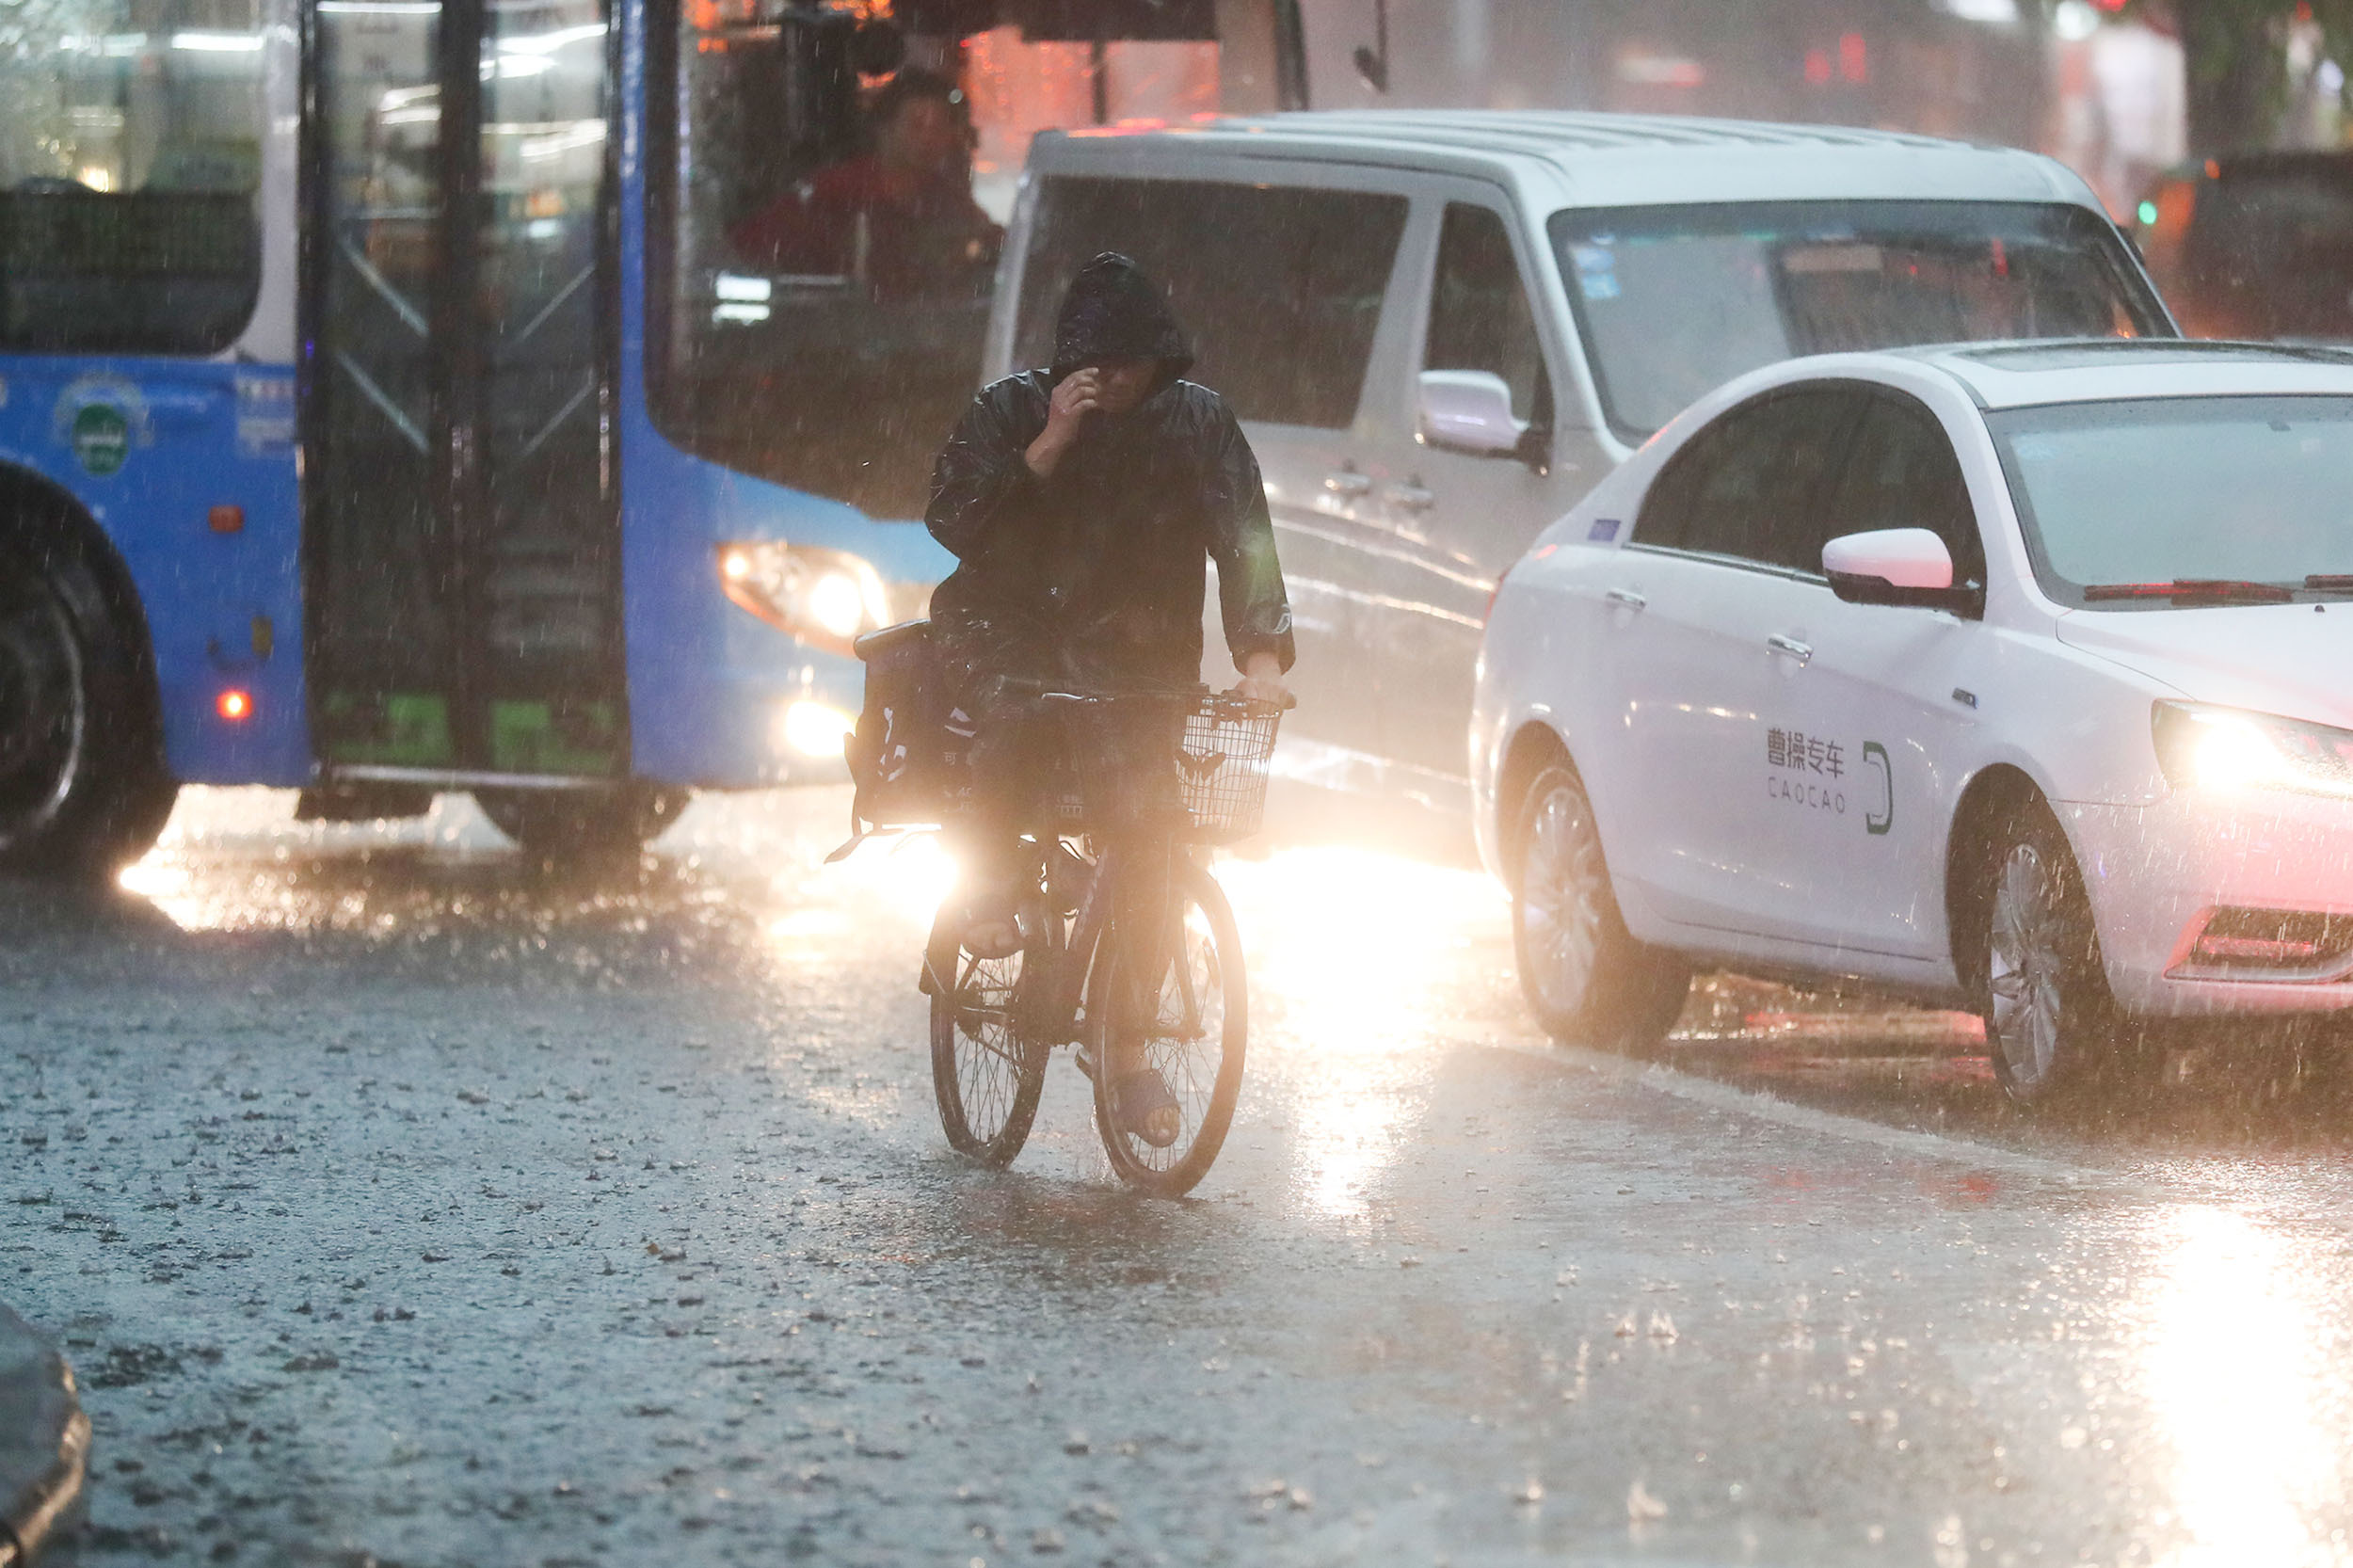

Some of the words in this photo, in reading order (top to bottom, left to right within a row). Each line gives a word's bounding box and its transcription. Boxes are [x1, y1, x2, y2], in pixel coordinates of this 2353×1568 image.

[1768, 728, 1844, 779] 曹操专车
[1769, 776, 1846, 814] CAOCAO
